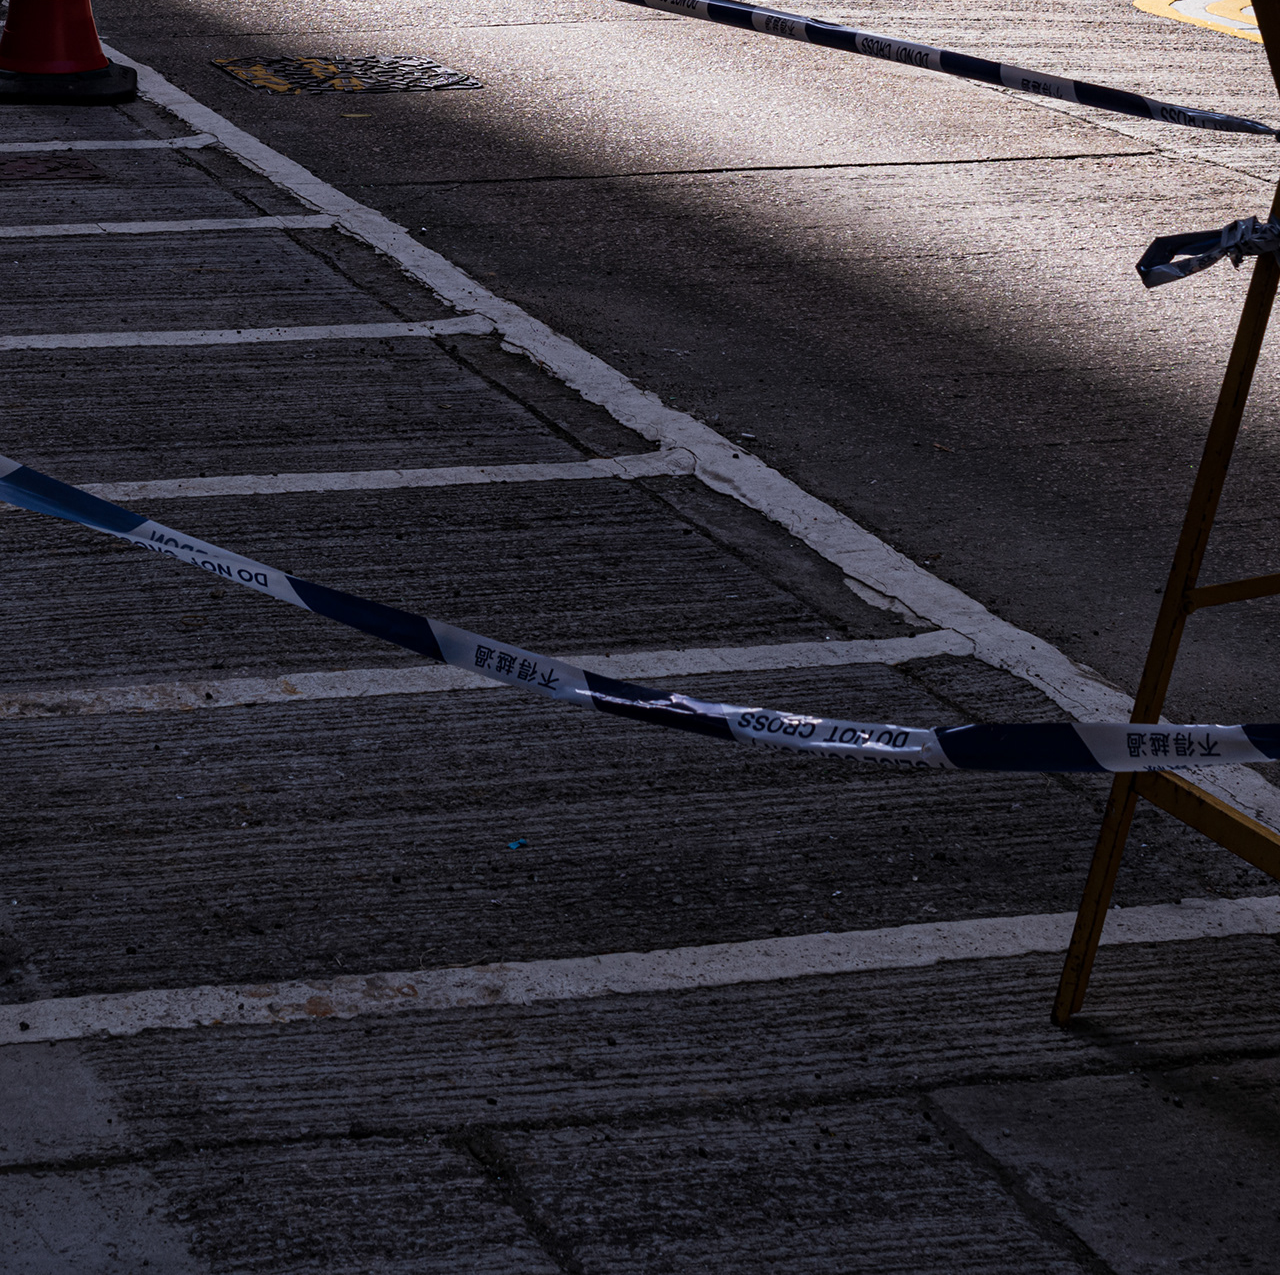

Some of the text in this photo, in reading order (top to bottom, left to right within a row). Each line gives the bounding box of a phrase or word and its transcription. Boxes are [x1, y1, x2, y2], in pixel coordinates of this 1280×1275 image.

[861, 37, 892, 60] CROSS
[236, 568, 269, 589] DO
[475, 643, 560, 691] 不得越過
[737, 711, 910, 749] DO NOT CROSS
[1127, 732, 1221, 758] 不得越過
